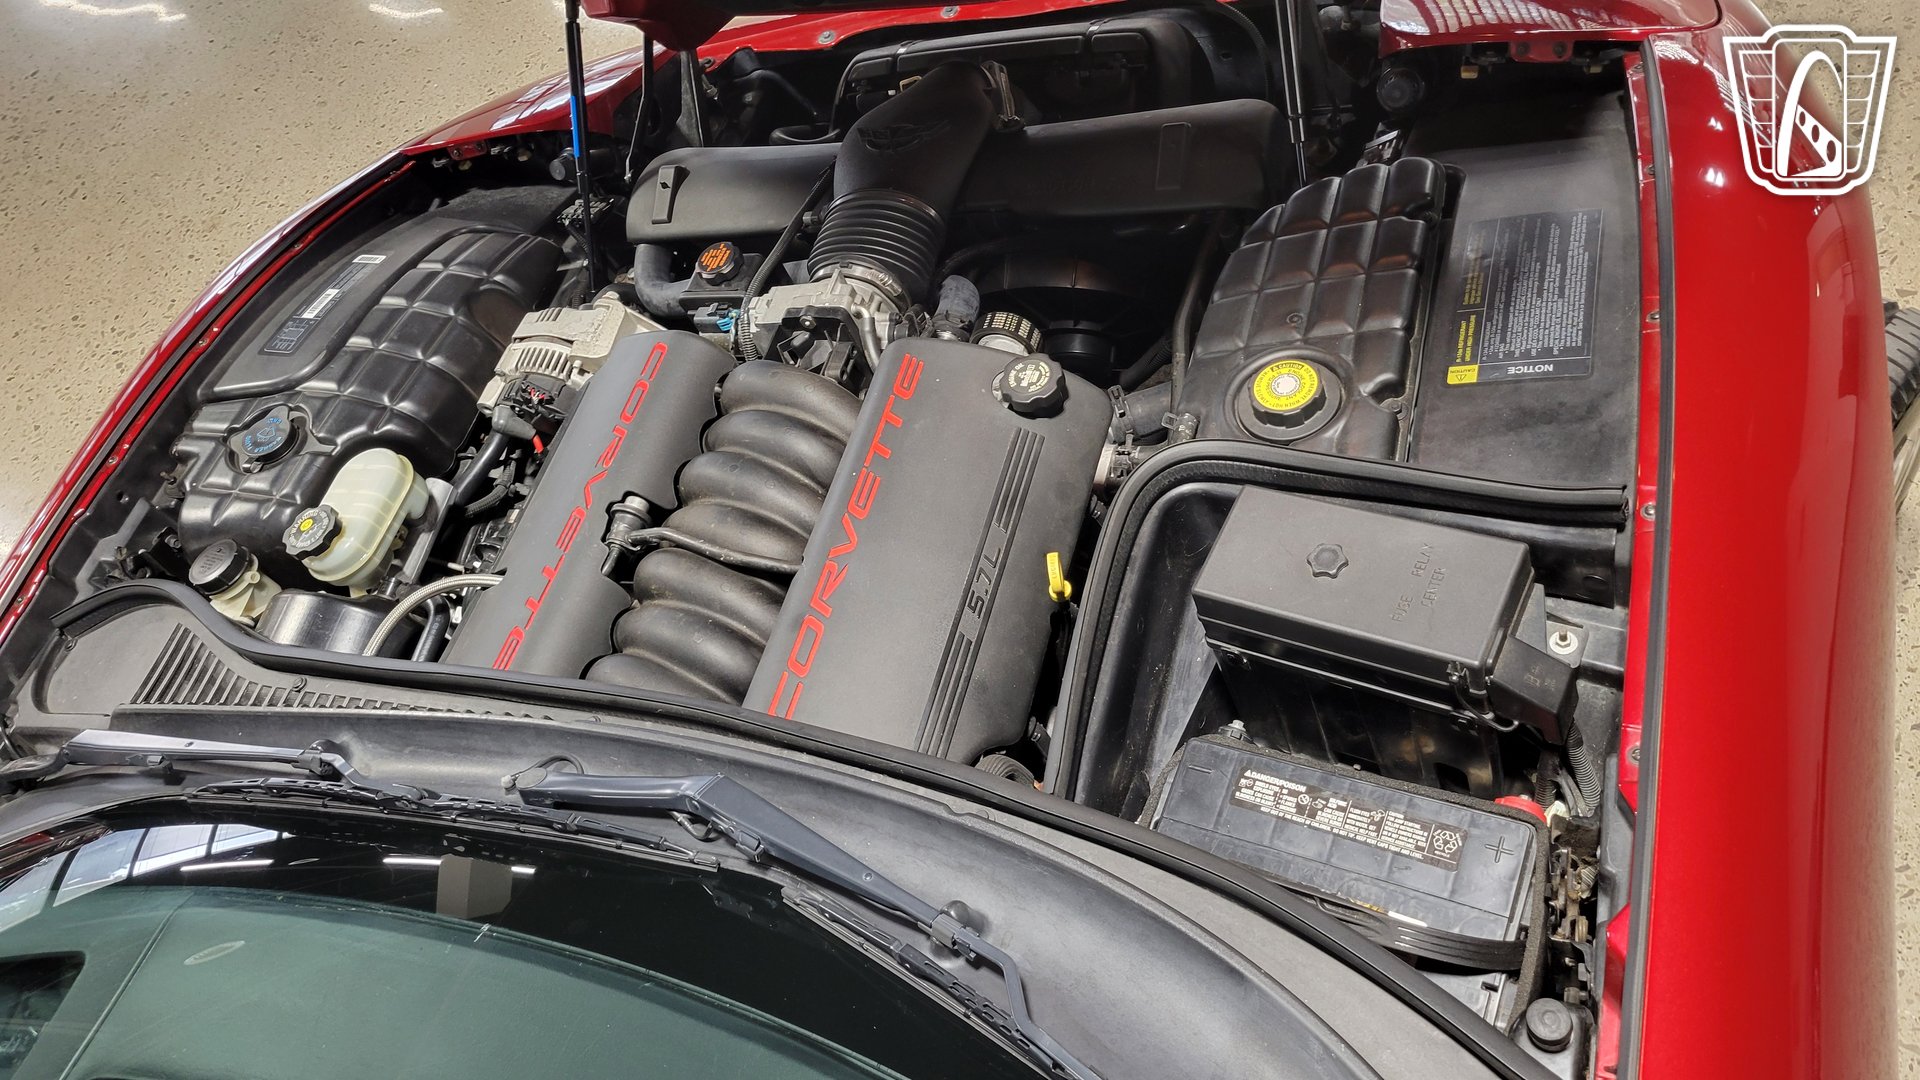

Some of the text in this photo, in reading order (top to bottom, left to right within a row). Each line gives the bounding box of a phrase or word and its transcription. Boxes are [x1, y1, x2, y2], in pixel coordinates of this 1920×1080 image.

[1507, 364, 1554, 375] NOTICE
[493, 341, 668, 670] CORVETTE
[768, 353, 925, 720] CORVETTE
[1411, 543, 1434, 577] RELAY
[967, 548, 1001, 619] 5.7L
[1421, 567, 1447, 607] CENTER
[1391, 595, 1414, 622] FUSE
